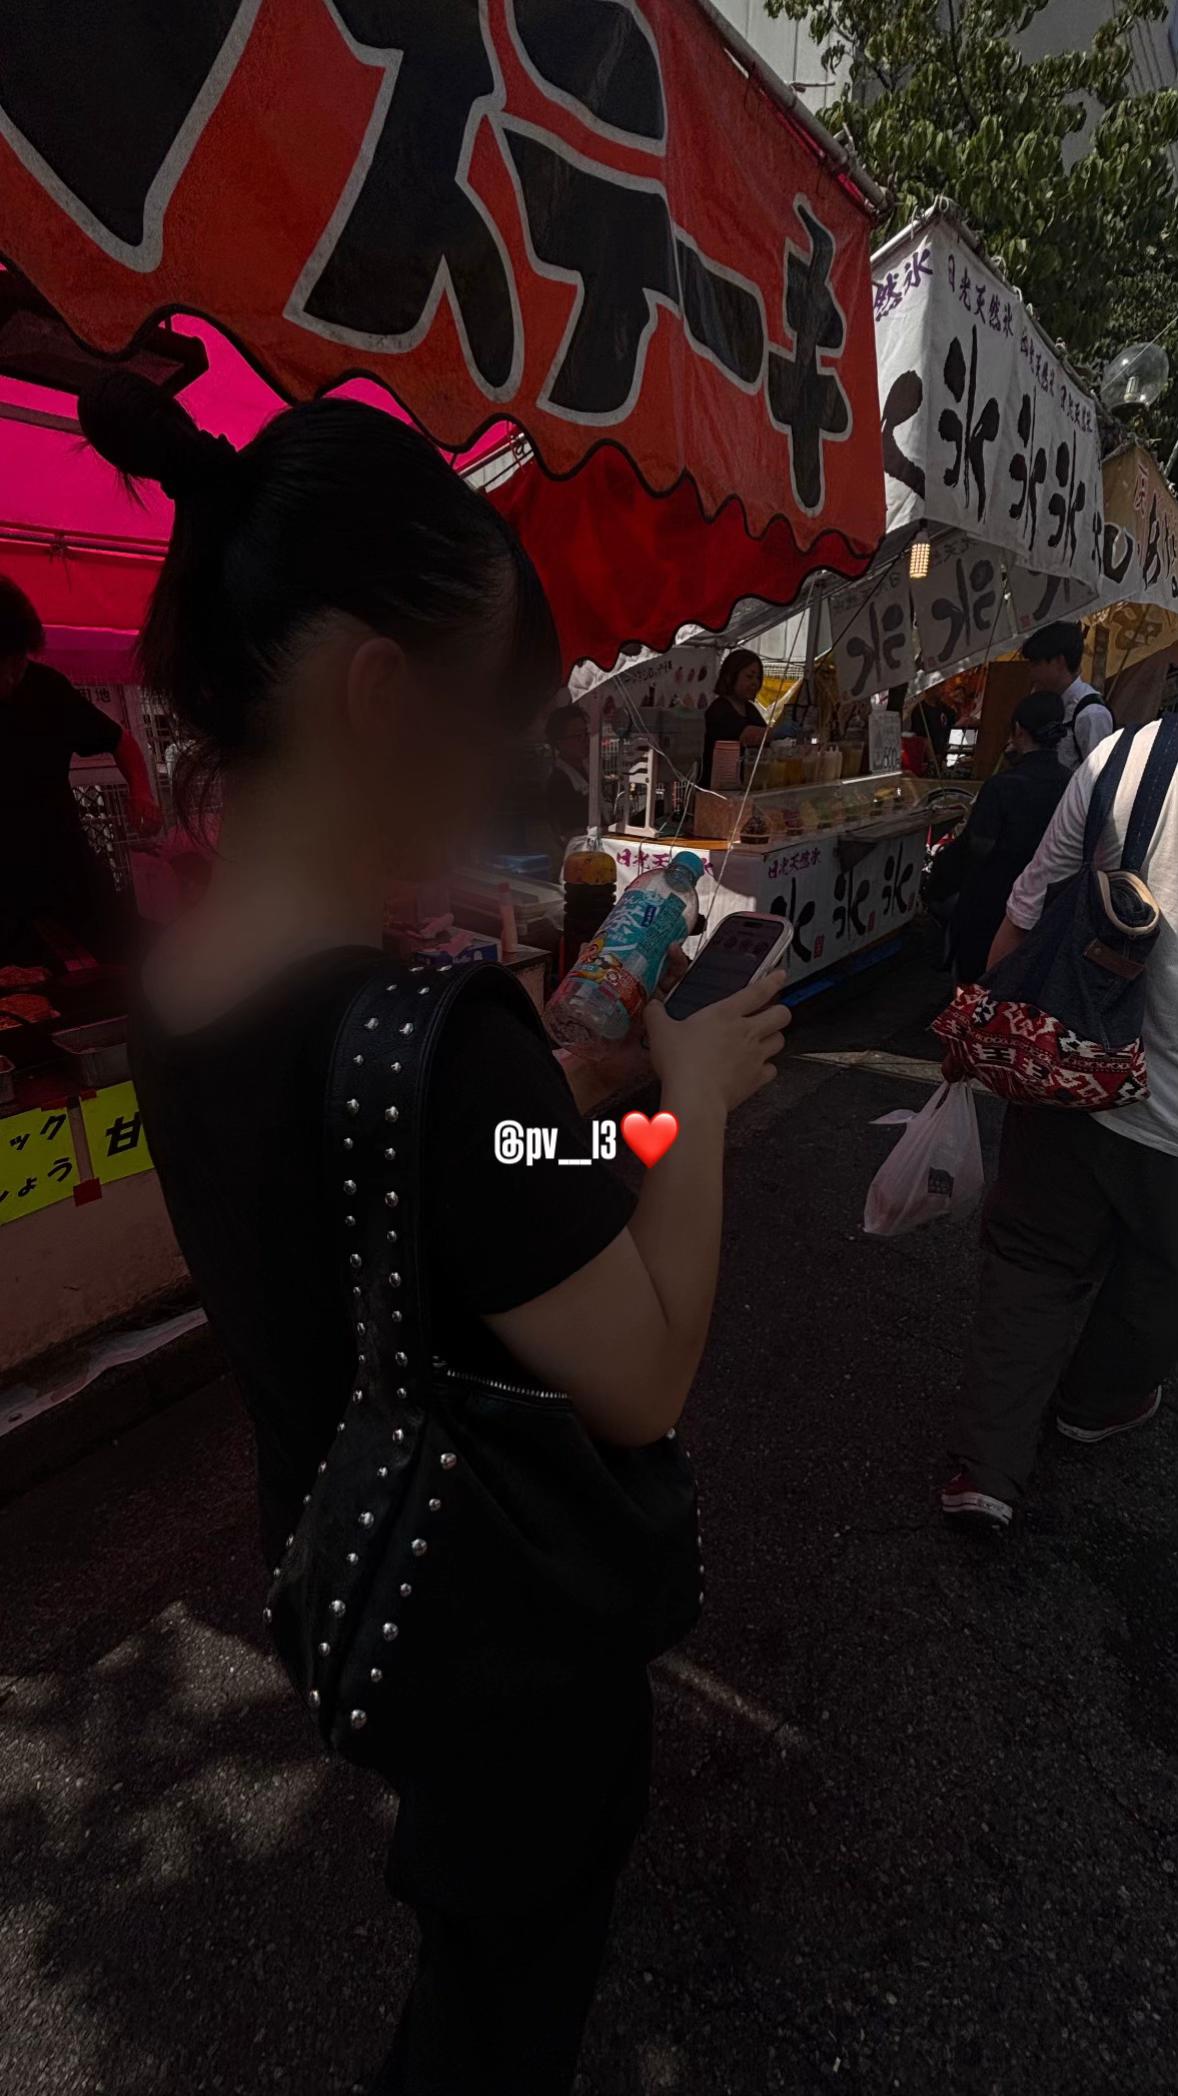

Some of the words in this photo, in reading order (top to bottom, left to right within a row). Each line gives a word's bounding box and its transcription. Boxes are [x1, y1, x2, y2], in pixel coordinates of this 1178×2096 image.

[938, 324, 1001, 523] 氷
[1009, 385, 1047, 551] 氷
[1048, 431, 1085, 566] 氷
[882, 841, 914, 917] 氷
[106, 1111, 141, 1156] 甘
